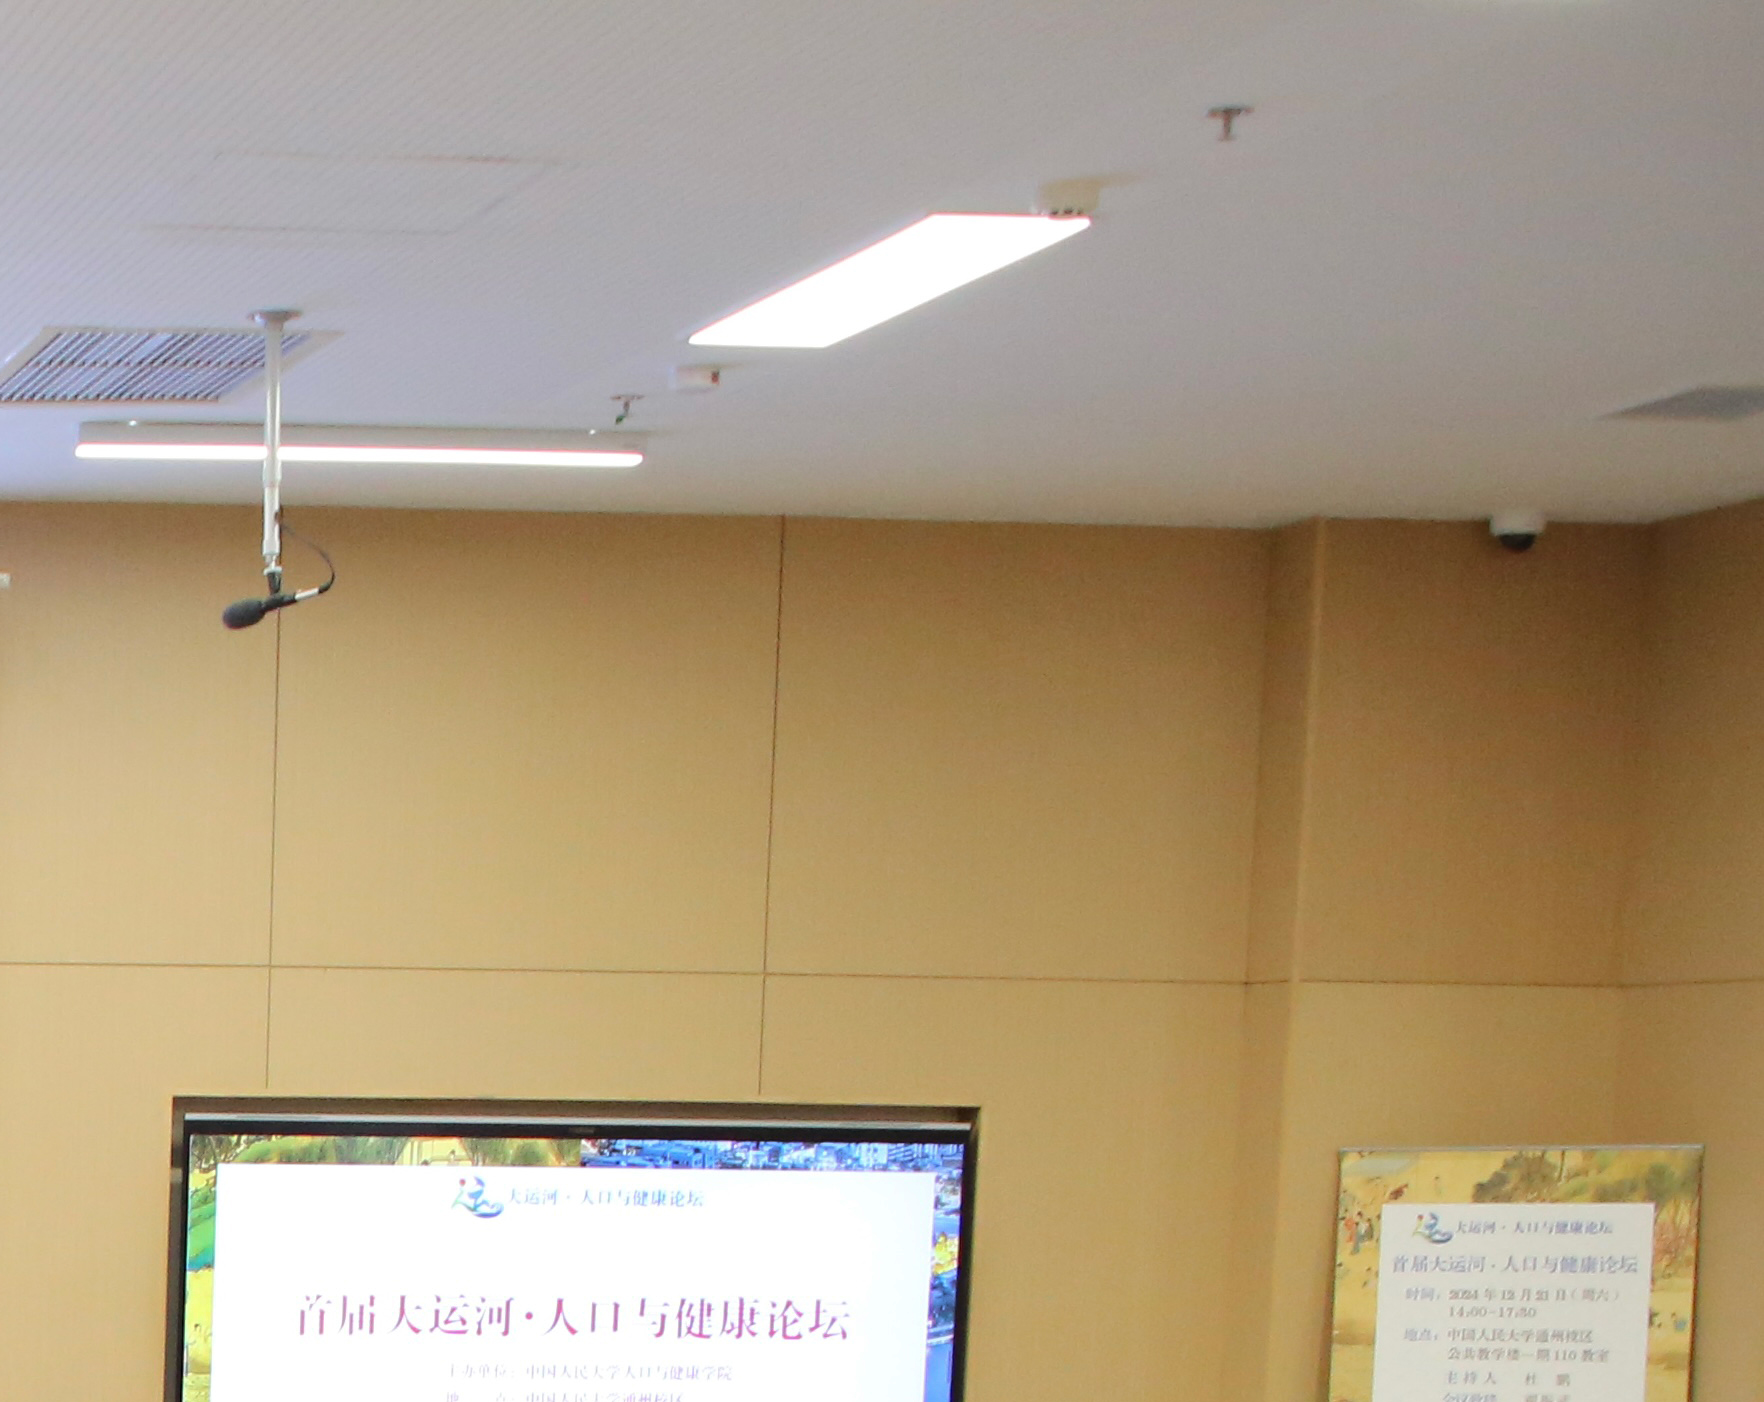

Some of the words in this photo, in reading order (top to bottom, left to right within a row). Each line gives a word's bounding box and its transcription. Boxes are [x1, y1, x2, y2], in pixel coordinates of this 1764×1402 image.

[295, 1294, 851, 1342] 首届大运河·人口与健康论坛
